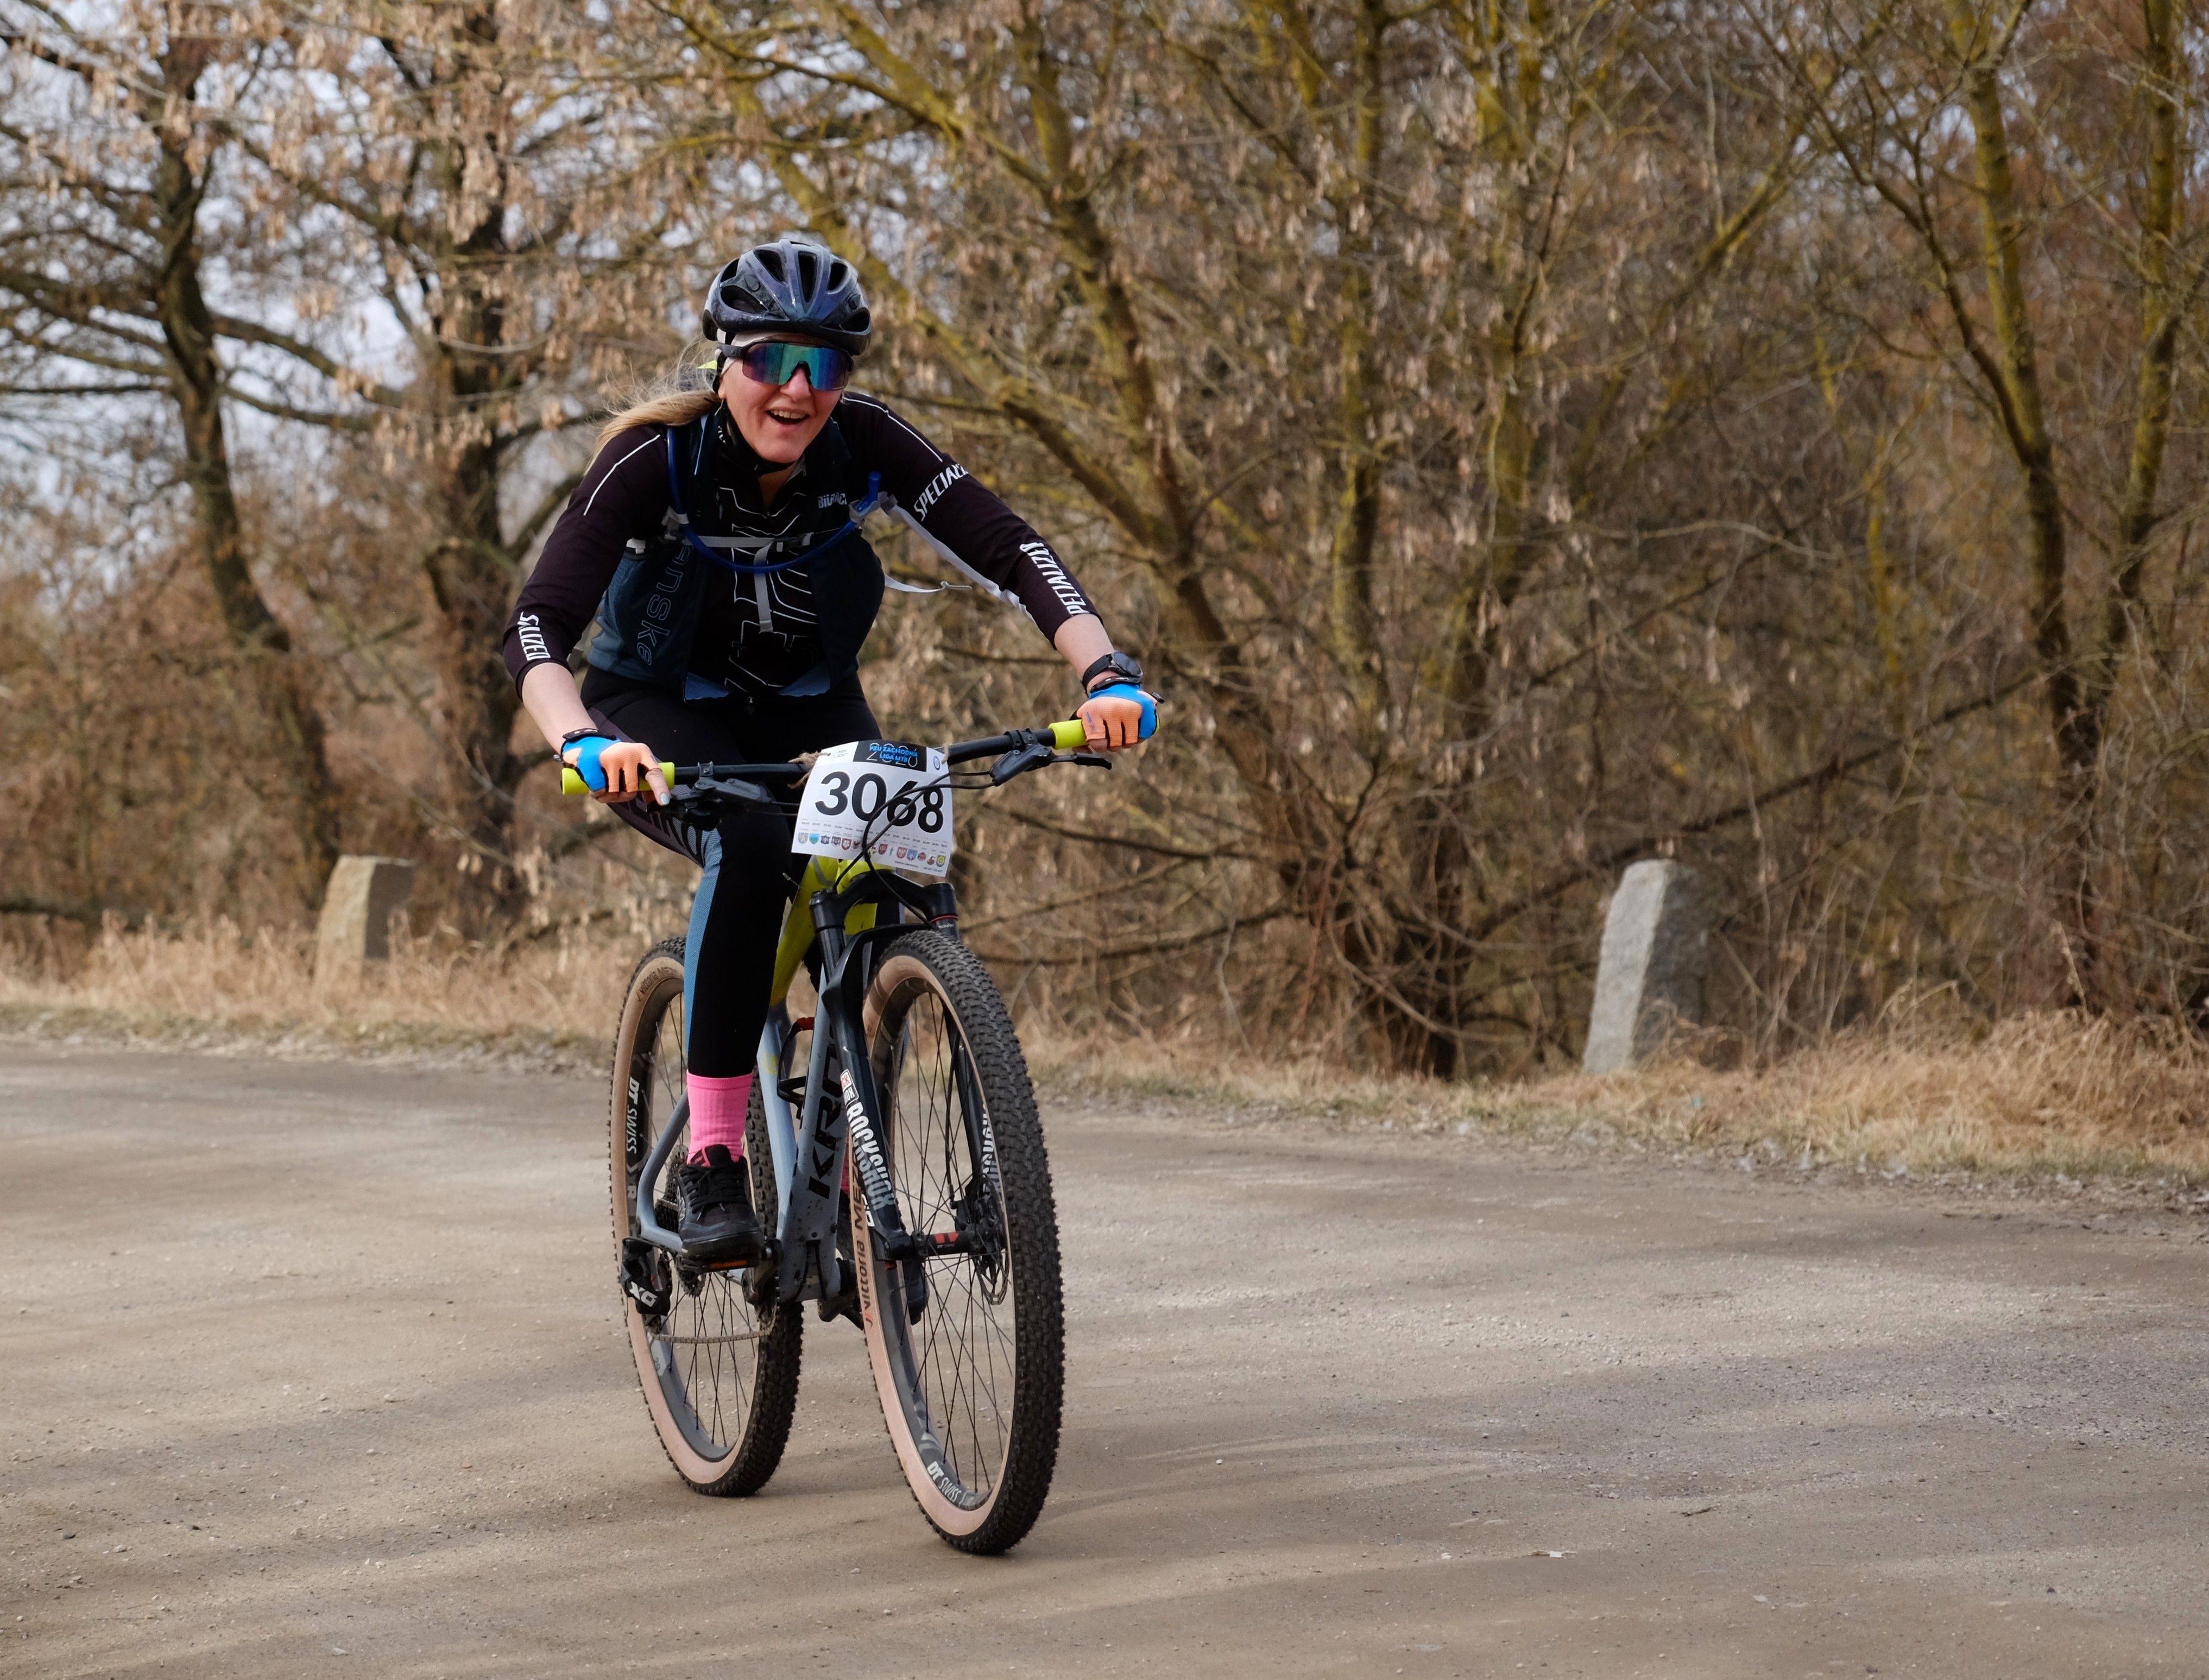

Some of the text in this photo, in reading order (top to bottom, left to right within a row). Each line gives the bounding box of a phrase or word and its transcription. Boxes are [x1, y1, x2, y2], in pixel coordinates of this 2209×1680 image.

[1019, 542, 1091, 615] PECIALIZED
[883, 747, 918, 757] ZACHODNIA
[815, 771, 944, 833] 3068
[626, 1076, 640, 1154] DT SWISS
[809, 1043, 843, 1199] KRO
[847, 1101, 895, 1211] ROCKSHOX
[927, 1461, 962, 1503] DT SWISS
